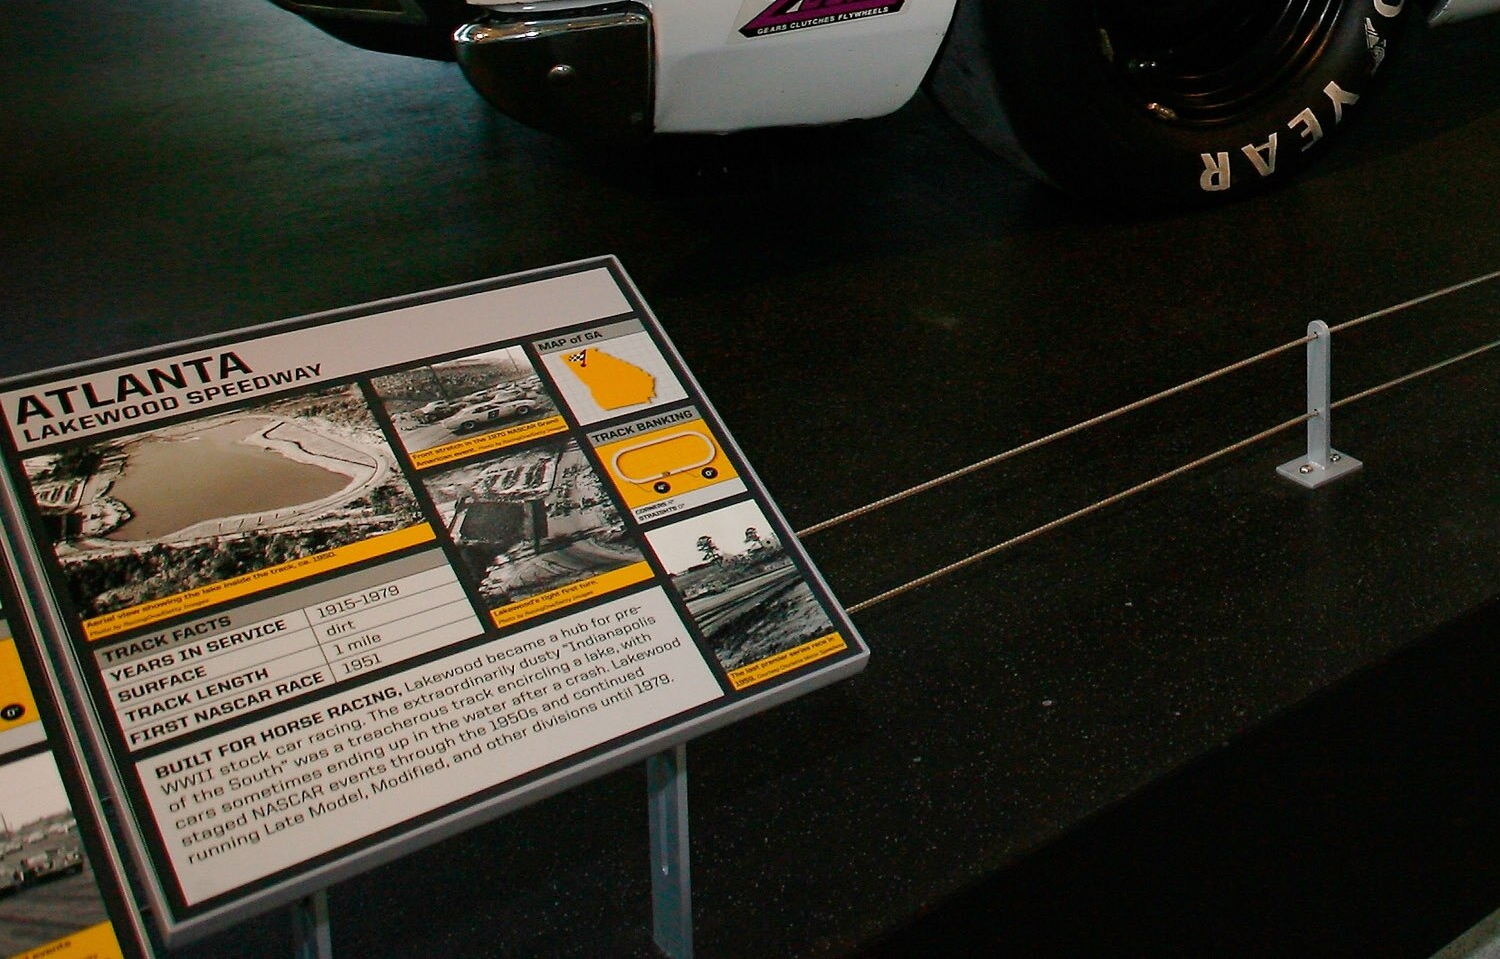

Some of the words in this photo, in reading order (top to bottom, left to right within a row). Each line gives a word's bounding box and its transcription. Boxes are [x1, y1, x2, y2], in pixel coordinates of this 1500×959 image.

[757, 24, 787, 35] GEARS
[790, 16, 835, 29] CLUTCHES
[838, 7, 889, 21] FLYWHEELS
[538, 338, 566, 351] MAP
[569, 336, 582, 344] of
[584, 330, 603, 340] GA
[17, 351, 253, 425] ATLANTA
[23, 396, 179, 443] LAKEWOOD
[187, 363, 321, 405] SPEEDWAY
[592, 426, 635, 443] TRACK
[637, 410, 693, 431] BANKING
[87, 614, 116, 629] Aerial
[142, 595, 183, 613] showing
[184, 590, 200, 601] the
[223, 576, 251, 589] inside
[253, 570, 269, 581] the
[270, 562, 297, 576] track,
[102, 635, 168, 663] TRACK
[173, 616, 232, 641] FACTS
[110, 653, 176, 682] YEARS
[178, 644, 203, 661] IN
[206, 619, 288, 653] SERVICE
[318, 585, 399, 619] 1915-1979
[118, 665, 208, 703] SURFACE
[326, 618, 356, 637] dirt
[125, 693, 192, 723] TRACK
[197, 667, 269, 700] LENGTH
[335, 643, 343, 656] 1
[347, 631, 382, 652] mile
[130, 716, 190, 745] FIRST
[195, 689, 272, 723] NASCAR
[275, 671, 325, 696] RACE
[344, 653, 383, 674] 1951
[155, 749, 215, 779] BUILT
[218, 735, 258, 759] FOR
[260, 712, 324, 742] HORSE
[327, 686, 402, 719] RACING.
[405, 657, 482, 692] Lakewood
[486, 637, 547, 665] became
[549, 633, 559, 643] a
[561, 621, 589, 639] hub
[590, 614, 612, 629] for
[615, 605, 642, 623] pre-
[160, 772, 215, 795] WWII
[219, 751, 271, 775] stock
[276, 740, 303, 756] car
[308, 720, 367, 746] racing.
[369, 704, 399, 722] The
[403, 663, 516, 711] extraordinarily
[519, 646, 562, 670] dusty
[168, 797, 189, 813] of
[192, 785, 225, 803] the
[293, 748, 330, 766] was
[334, 743, 345, 754] a
[347, 703, 449, 748] treacherous
[451, 689, 494, 710] track
[497, 661, 570, 696] encircling
[573, 656, 583, 666] a
[584, 645, 620, 664] lake,
[621, 633, 652, 650] with
[175, 811, 217, 830] cars
[222, 772, 323, 812] sometimes
[327, 747, 385, 774] ending
[389, 735, 409, 751] up
[414, 726, 430, 741] in
[431, 718, 459, 737] the
[463, 702, 508, 723] water
[511, 686, 549, 706] after
[553, 682, 562, 691] a
[565, 665, 610, 687] crash.
[612, 638, 681, 670] Lakewood
[182, 813, 248, 847] staged
[252, 784, 324, 820] NASCAR
[329, 764, 387, 791] events
[389, 735, 457, 769] through
[459, 726, 487, 743] the
[490, 707, 538, 732] 1950s
[542, 694, 570, 713] and
[573, 668, 645, 701] continued
[187, 829, 261, 864] running
[264, 813, 305, 835] Late
[309, 788, 369, 818] Model,
[371, 753, 451, 793] Modified,
[453, 745, 482, 763] and
[486, 728, 528, 749] other
[532, 702, 598, 733] divisions
[601, 687, 633, 707] until
[637, 673, 674, 695] 1979.
